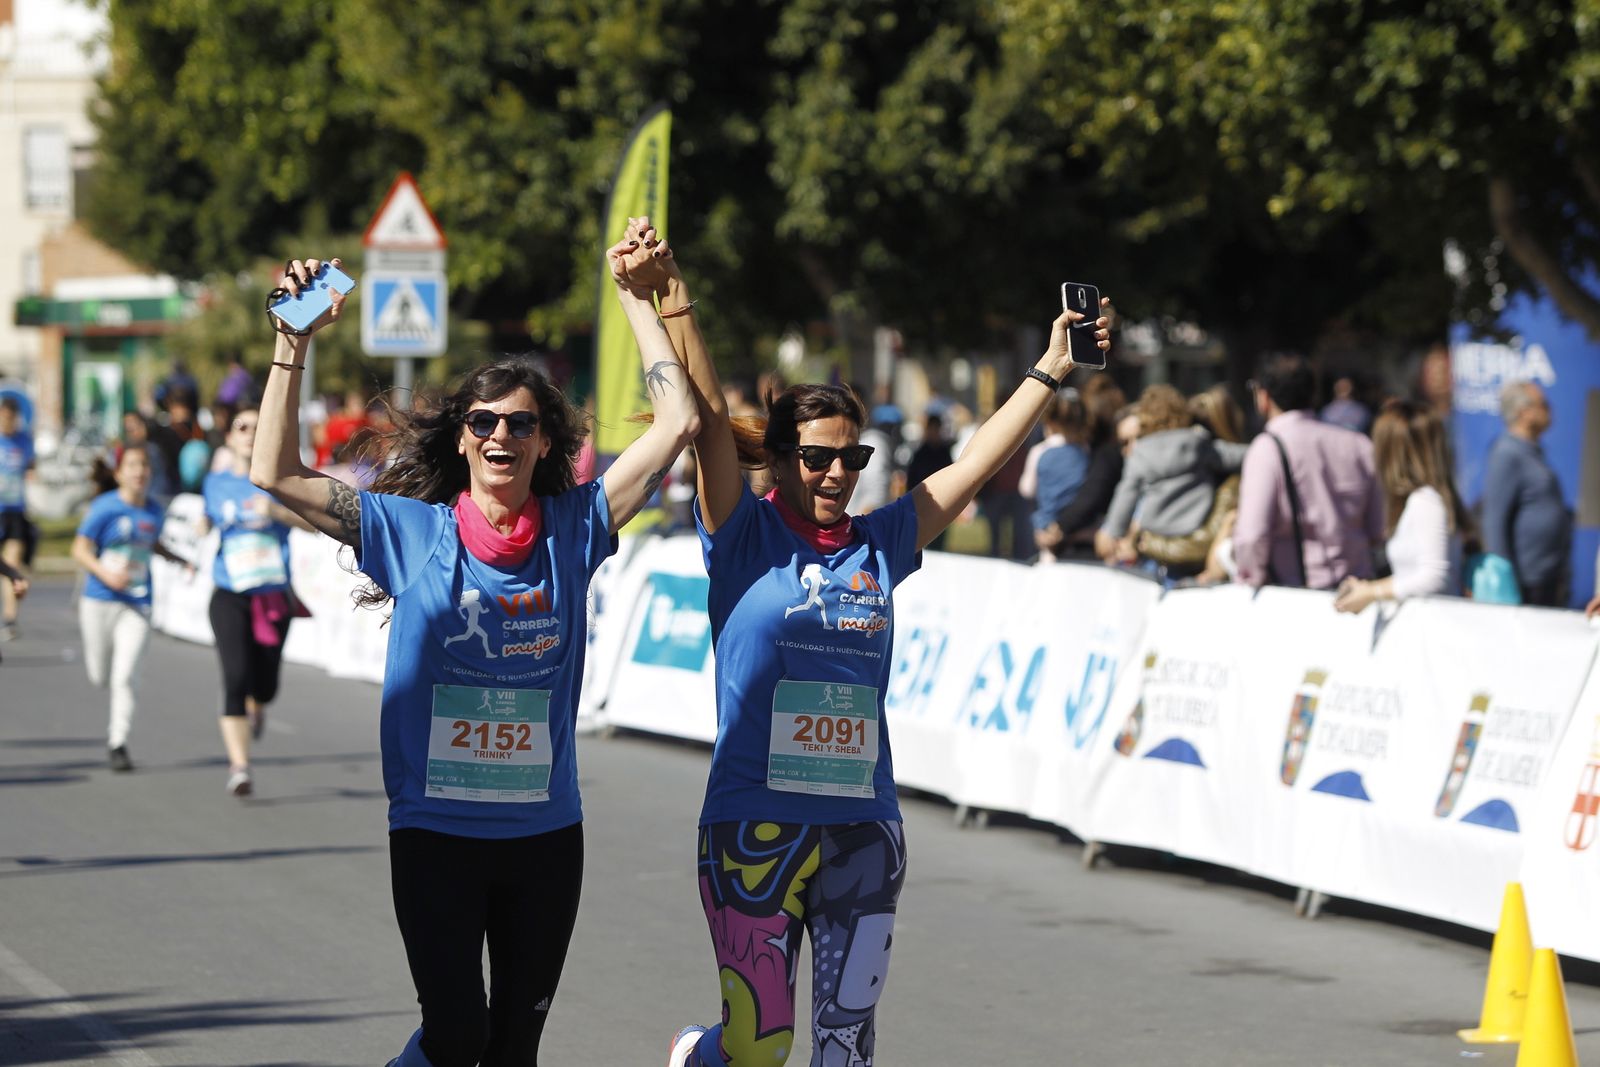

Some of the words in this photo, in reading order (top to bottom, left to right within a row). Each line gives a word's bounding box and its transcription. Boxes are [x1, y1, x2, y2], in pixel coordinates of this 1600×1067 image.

[496, 588, 553, 618] VIII
[502, 616, 560, 631] CARRERA
[502, 634, 561, 659] mujer
[786, 641, 825, 652] IGUALDAD
[827, 645, 835, 653] ES
[836, 647, 864, 656] NUESTRA
[496, 691, 516, 701] VIII
[837, 685, 853, 696] VIII
[450, 720, 532, 751] 2152
[792, 715, 865, 746] 2091
[473, 750, 513, 760] TRINIKY
[801, 743, 824, 752] TEKI
[826, 745, 834, 753] Y
[834, 745, 862, 755] SHEBA
